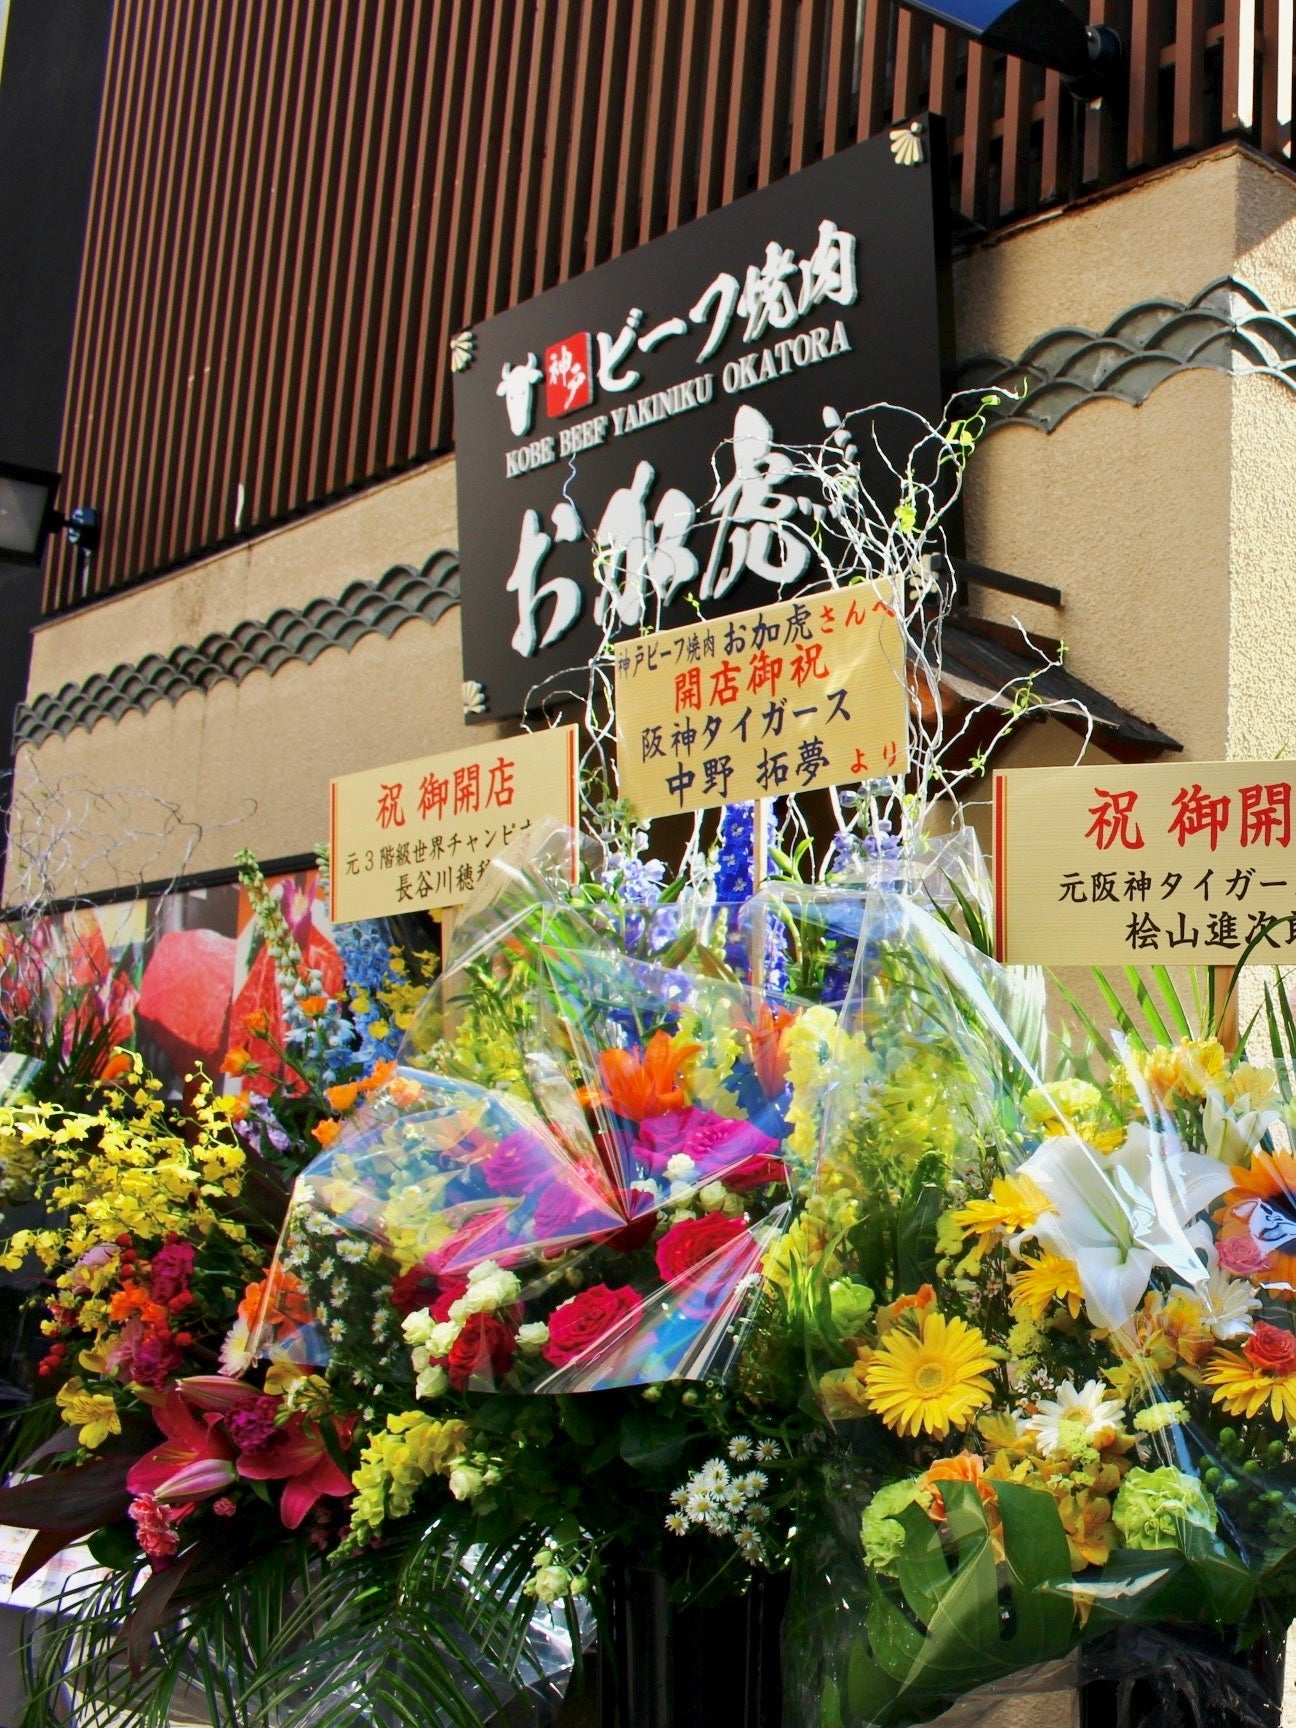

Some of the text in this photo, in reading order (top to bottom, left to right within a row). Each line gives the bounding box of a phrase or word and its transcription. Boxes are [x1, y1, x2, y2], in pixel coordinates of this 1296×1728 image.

[505, 320, 852, 479] KOBE BEEF YAKINIKU OKATORA
[504, 403, 832, 658] お加虎
[674, 642, 830, 714] 開店御祝
[641, 688, 852, 764] 阪神タイガース
[375, 756, 516, 830] 祝 御開店
[665, 735, 898, 809] 中野 拓夢 より
[1083, 786, 1146, 851] 祝
